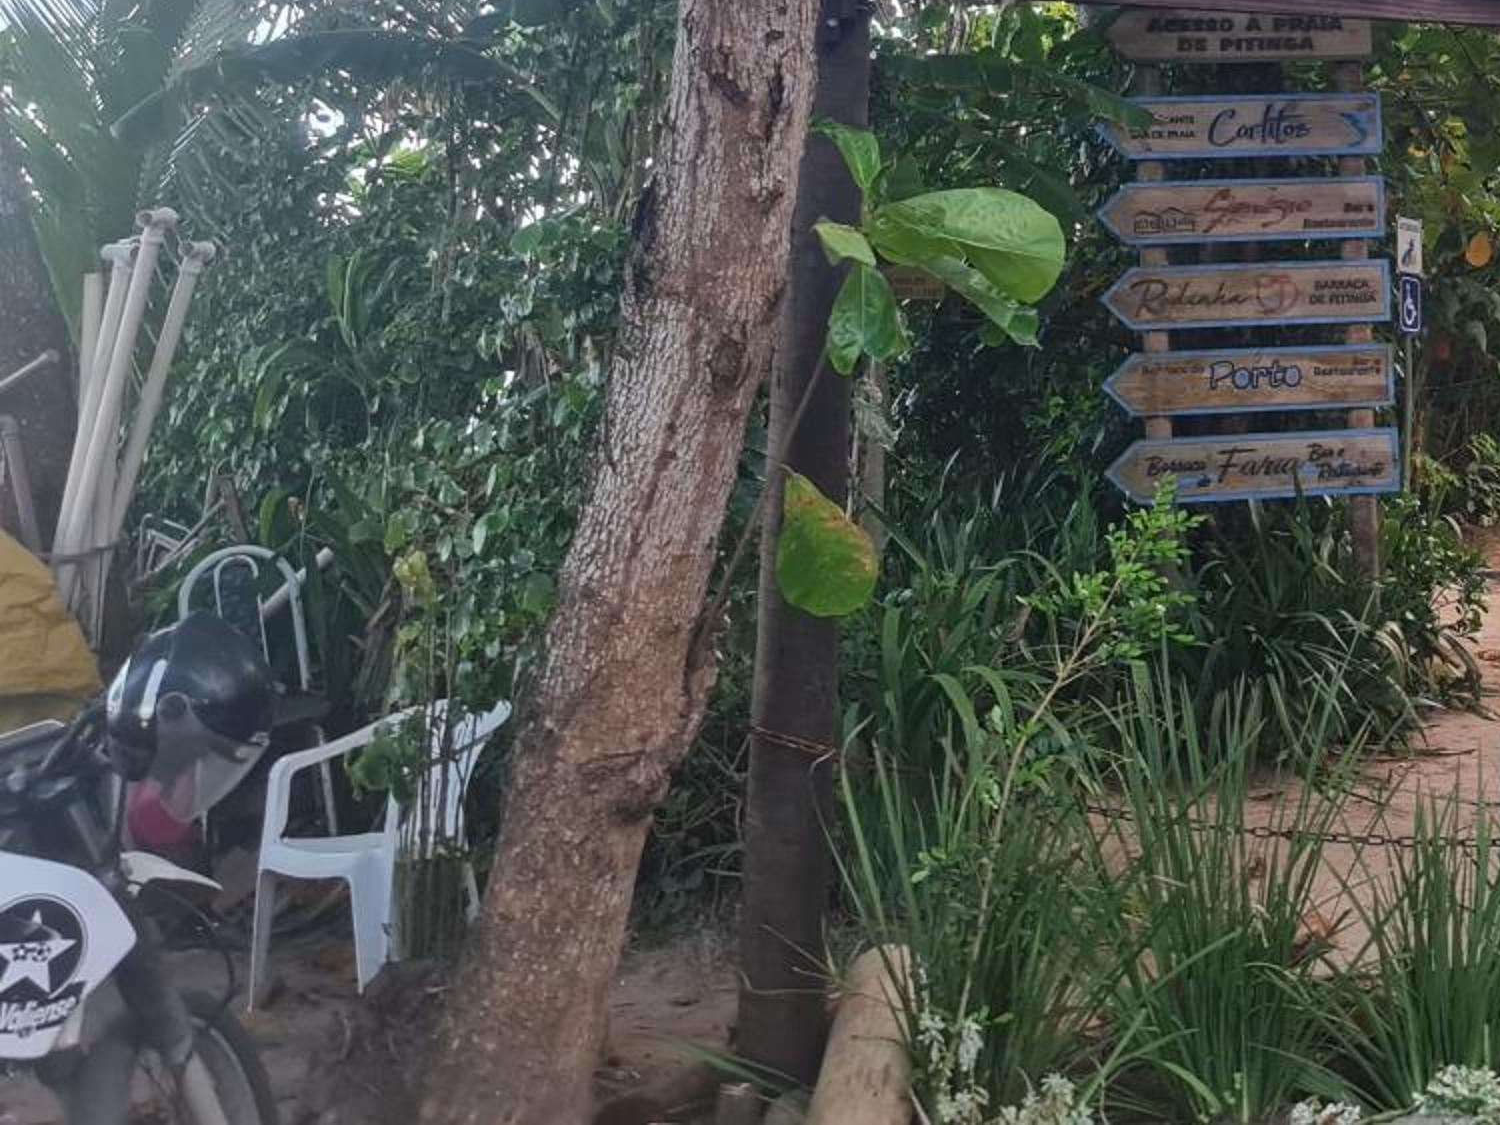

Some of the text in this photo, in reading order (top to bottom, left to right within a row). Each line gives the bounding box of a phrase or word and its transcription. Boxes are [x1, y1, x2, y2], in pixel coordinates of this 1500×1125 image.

[1272, 16, 1344, 33] PRAIA
[1176, 35, 1314, 52] DE PITINGA
[1207, 103, 1313, 148] Carlitos
[1208, 358, 1303, 391] Porto
